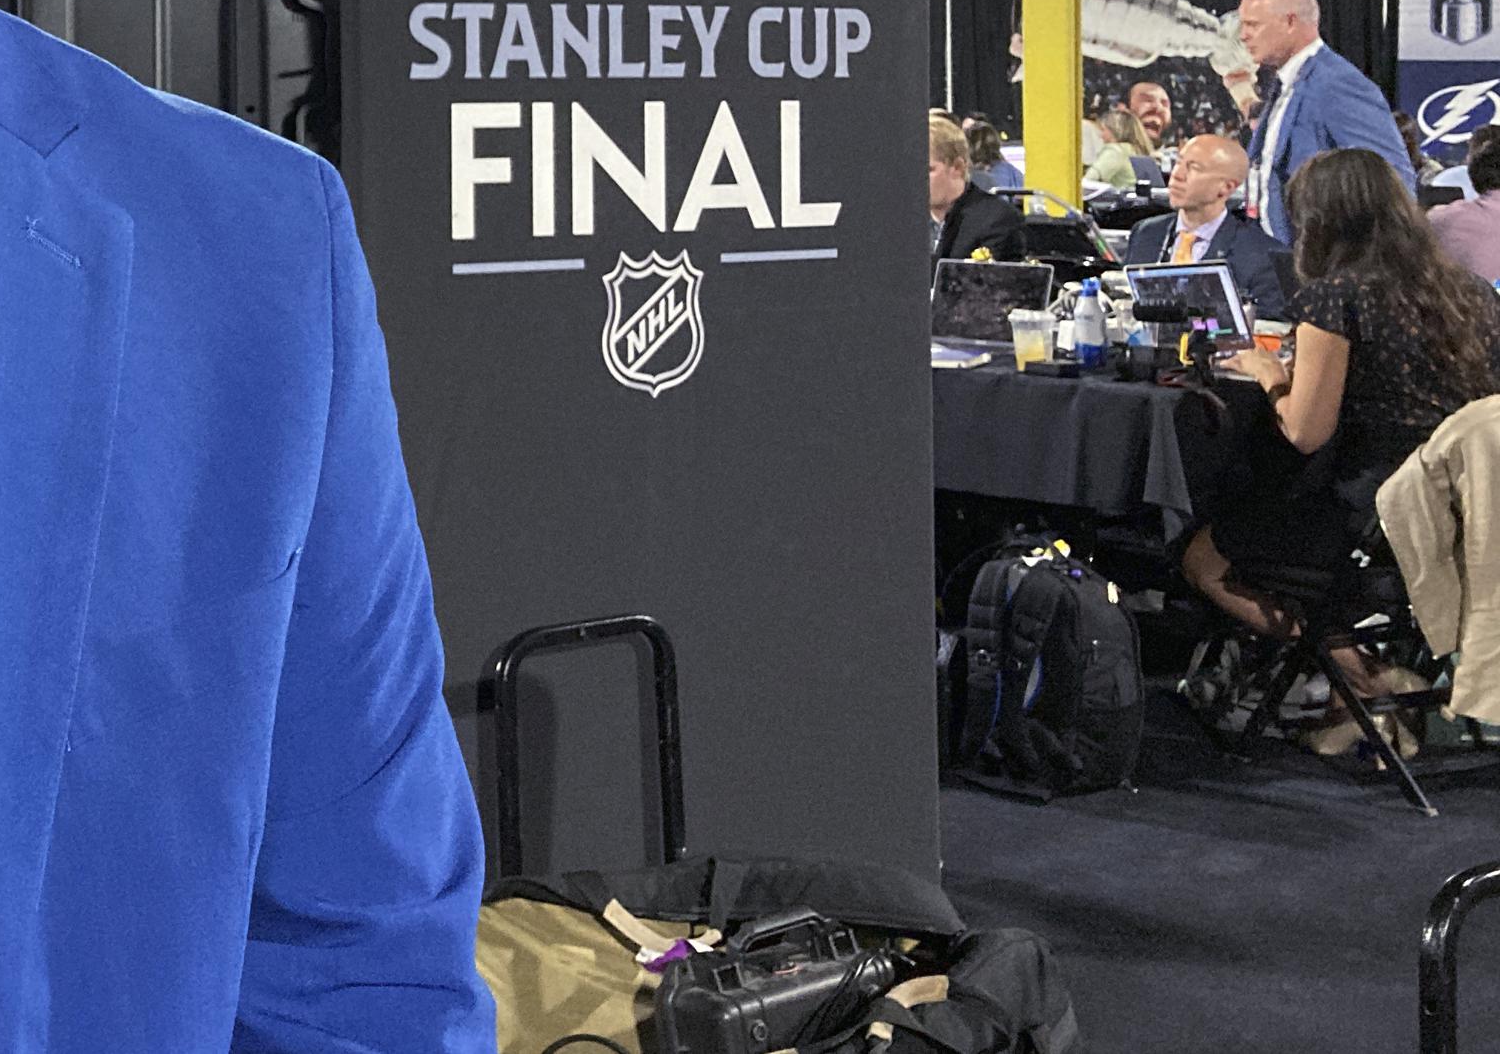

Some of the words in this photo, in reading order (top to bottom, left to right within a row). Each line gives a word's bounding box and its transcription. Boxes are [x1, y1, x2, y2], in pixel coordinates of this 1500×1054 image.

[408, 2, 730, 80] STANLEY
[747, 6, 872, 79] CUP
[450, 100, 842, 241] FINAL
[625, 286, 685, 364] NHL
